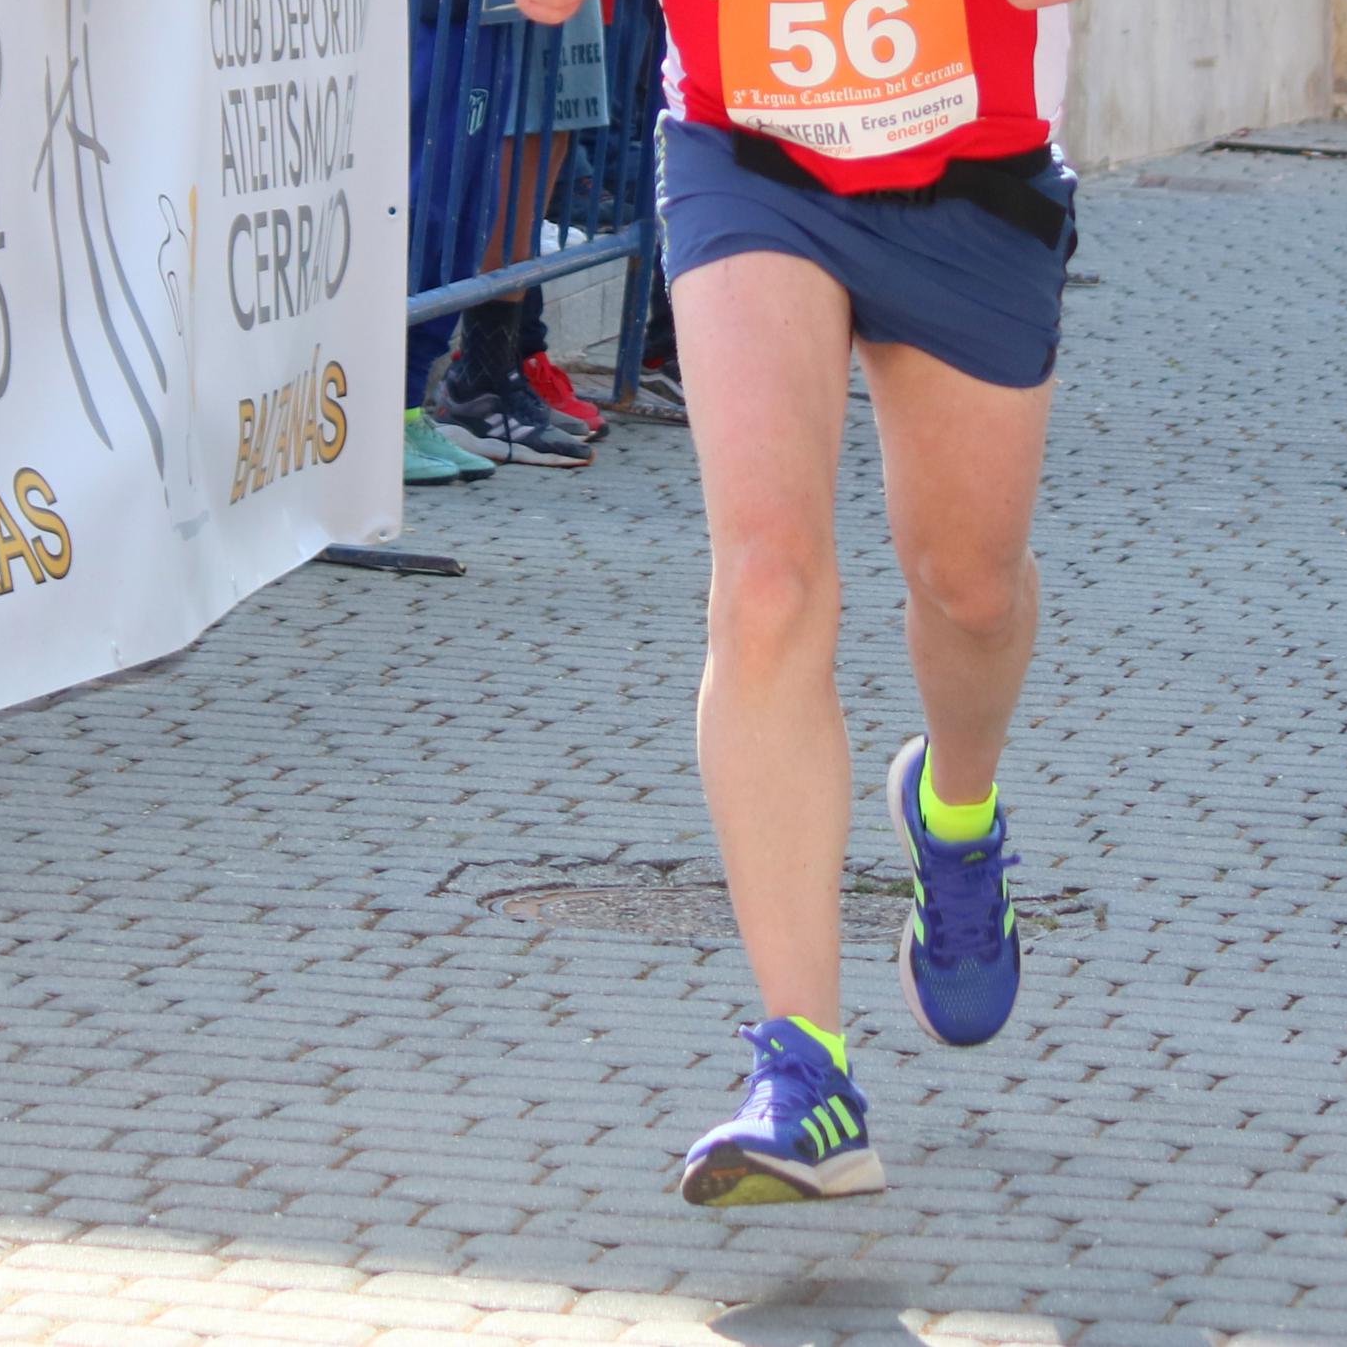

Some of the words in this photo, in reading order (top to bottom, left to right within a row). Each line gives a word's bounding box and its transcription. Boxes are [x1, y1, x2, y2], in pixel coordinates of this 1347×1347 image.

[749, 89, 797, 107] Legua
[800, 84, 881, 105] Castellana
[886, 80, 908, 94] del
[911, 62, 964, 88] Cerrato
[861, 115, 897, 131] Eres
[902, 94, 964, 122] nuestra
[887, 112, 950, 141] energía
[220, 75, 339, 197] ATLETISMO
